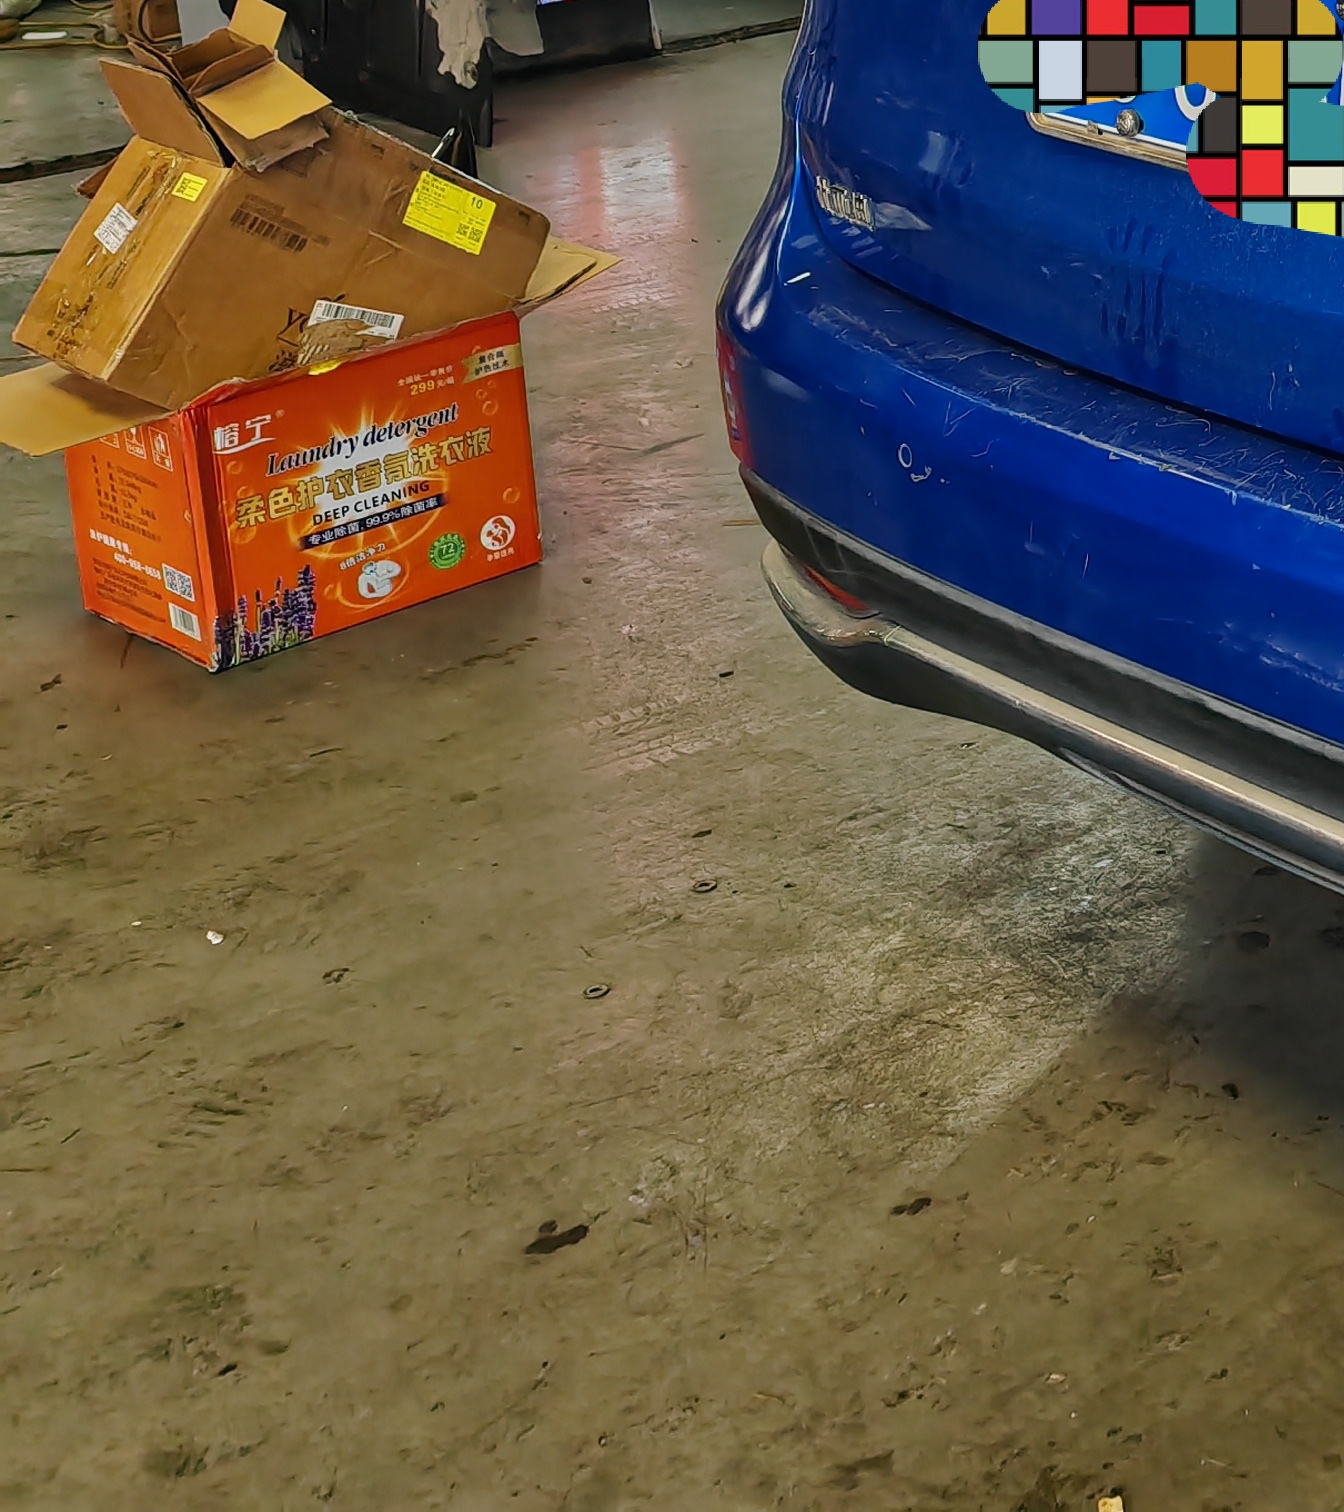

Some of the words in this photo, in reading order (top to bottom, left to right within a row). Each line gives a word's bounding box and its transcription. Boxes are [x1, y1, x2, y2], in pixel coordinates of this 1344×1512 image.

[265, 434, 359, 477] Laundry
[363, 402, 458, 447] detergent
[312, 506, 350, 527] DEEP
[353, 480, 430, 514] CLEANING
